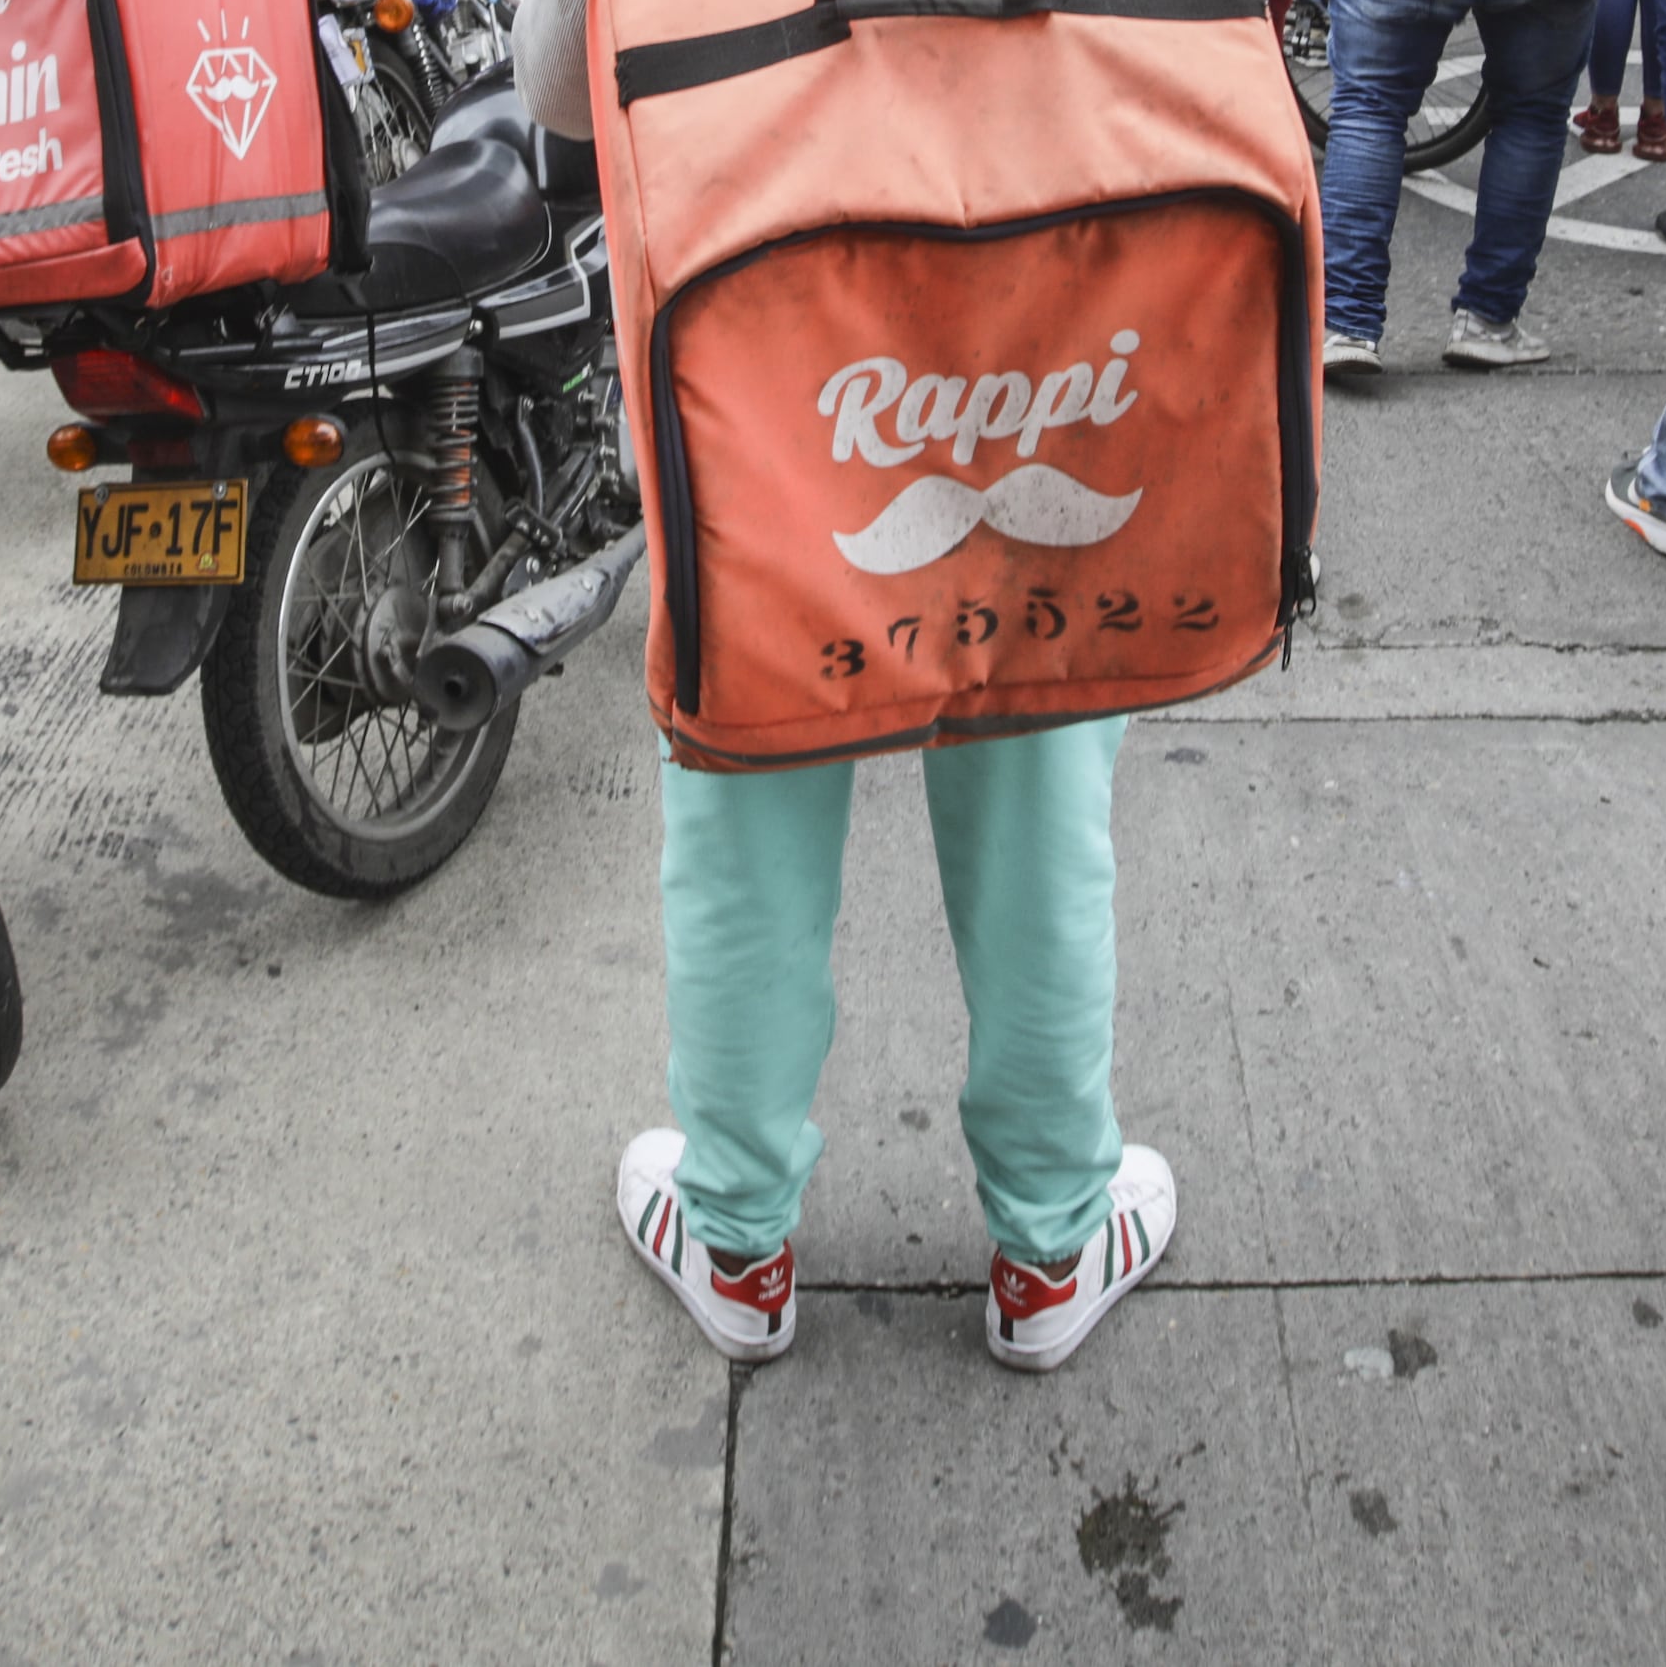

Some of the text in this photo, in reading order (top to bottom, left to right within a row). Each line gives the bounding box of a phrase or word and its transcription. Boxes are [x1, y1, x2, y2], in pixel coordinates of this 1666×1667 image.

[284, 359, 362, 390] CT100
[817, 329, 1140, 468] Rappi
[124, 562, 182, 576] COLOMBIA
